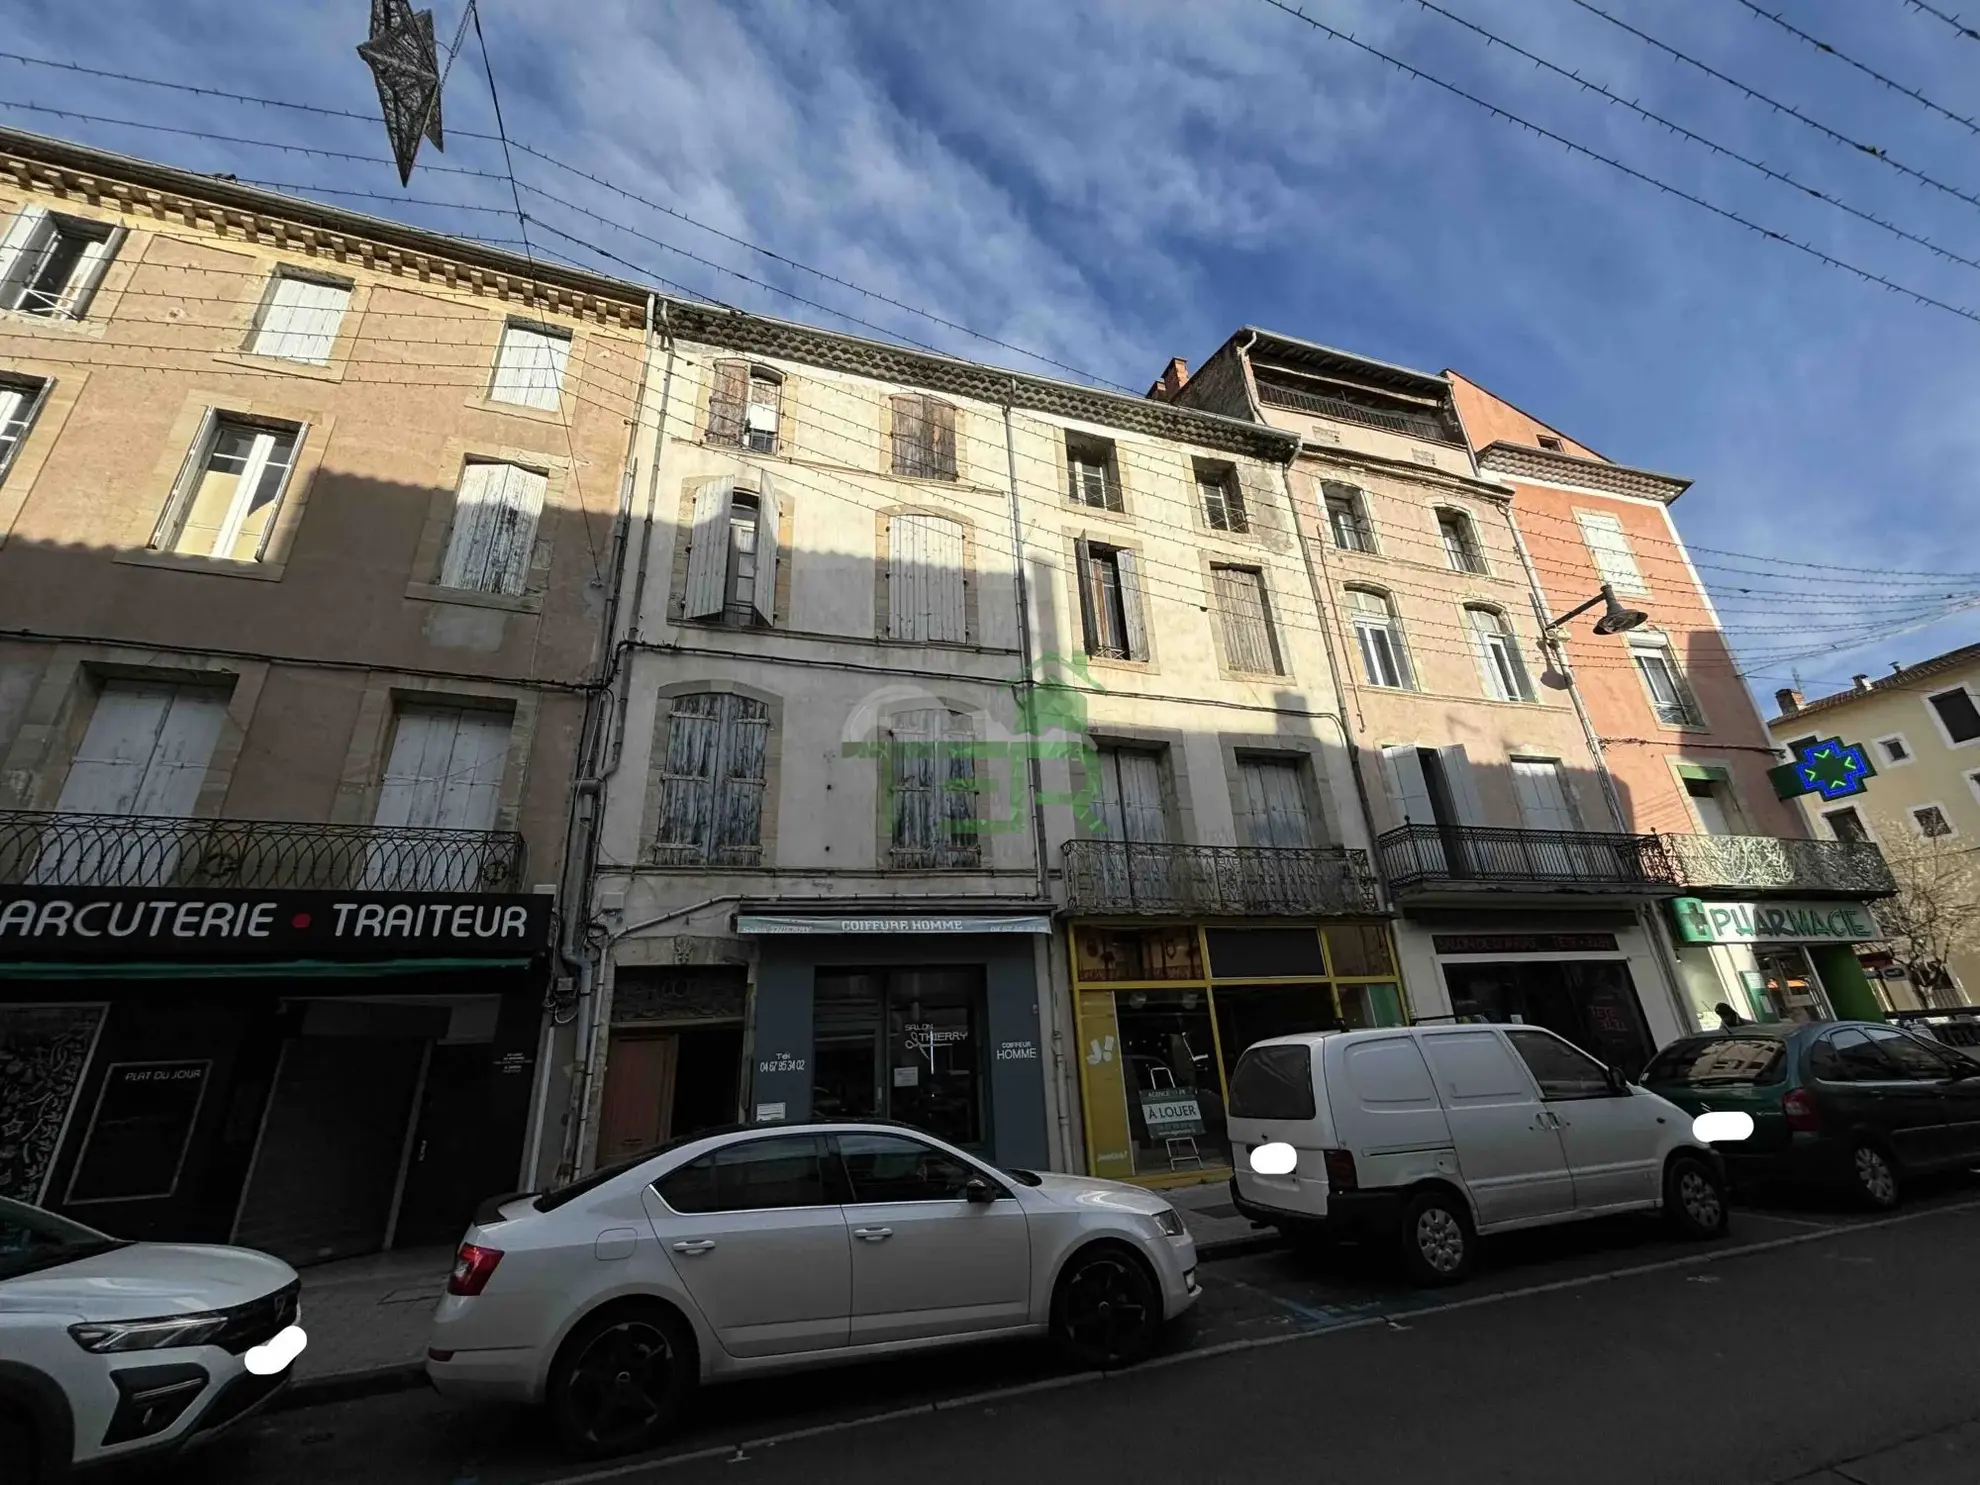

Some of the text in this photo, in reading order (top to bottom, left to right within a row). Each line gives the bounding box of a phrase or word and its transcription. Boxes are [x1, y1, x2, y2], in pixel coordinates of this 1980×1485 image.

[0, 899, 528, 938] ARCUTERIE TRAITEUR
[1708, 904, 1870, 938] PHARMACIE
[841, 919, 963, 932] COIFFURE HOMME
[904, 1023, 934, 1032] SALON
[917, 1031, 968, 1043] THIERRY
[996, 1047, 1037, 1060] HOMME
[760, 1062, 768, 1073] 04
[787, 1060, 796, 1071] 34
[796, 1059, 805, 1071] 02
[124, 1069, 203, 1082] PLAT DU JOUR
[1159, 1105, 1196, 1118] LOUER
